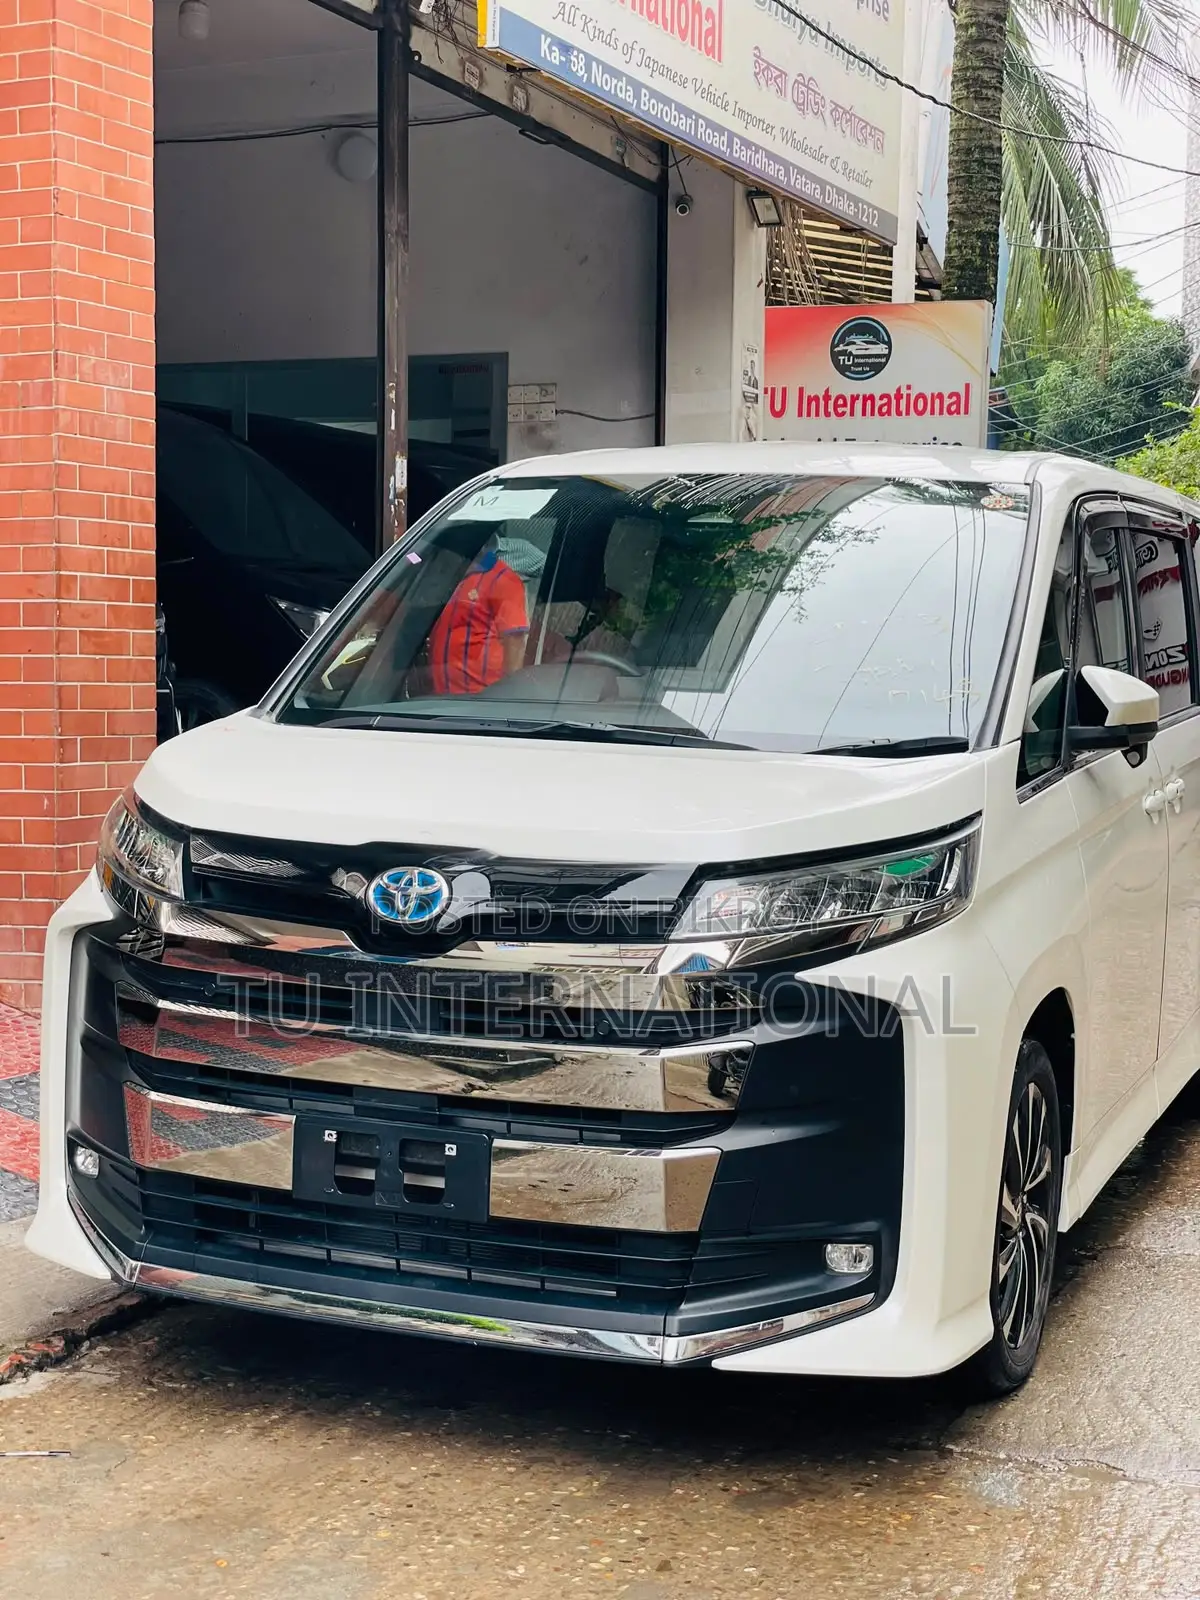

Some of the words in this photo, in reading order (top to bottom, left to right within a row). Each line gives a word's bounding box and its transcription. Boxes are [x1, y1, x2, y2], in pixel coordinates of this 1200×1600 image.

[617, 0, 723, 62] ational
[553, 1, 577, 27] All
[581, 14, 619, 50] Kinds
[622, 43, 638, 64] of
[636, 48, 689, 89] Japanese
[691, 77, 730, 112] Vehicle
[732, 101, 776, 141] Importer,
[779, 126, 830, 165] Wholesaler
[830, 158, 840, 173] &
[842, 162, 873, 190] Retailer
[591, 62, 638, 109] Norda,
[640, 88, 696, 136] Borobari
[698, 119, 730, 157] Road,
[733, 137, 788, 184] Baridhara,
[789, 165, 824, 204] Vatara,
[826, 184, 879, 228] Dhaka-1212
[838, 356, 853, 365] TU
[796, 383, 971, 418] International
